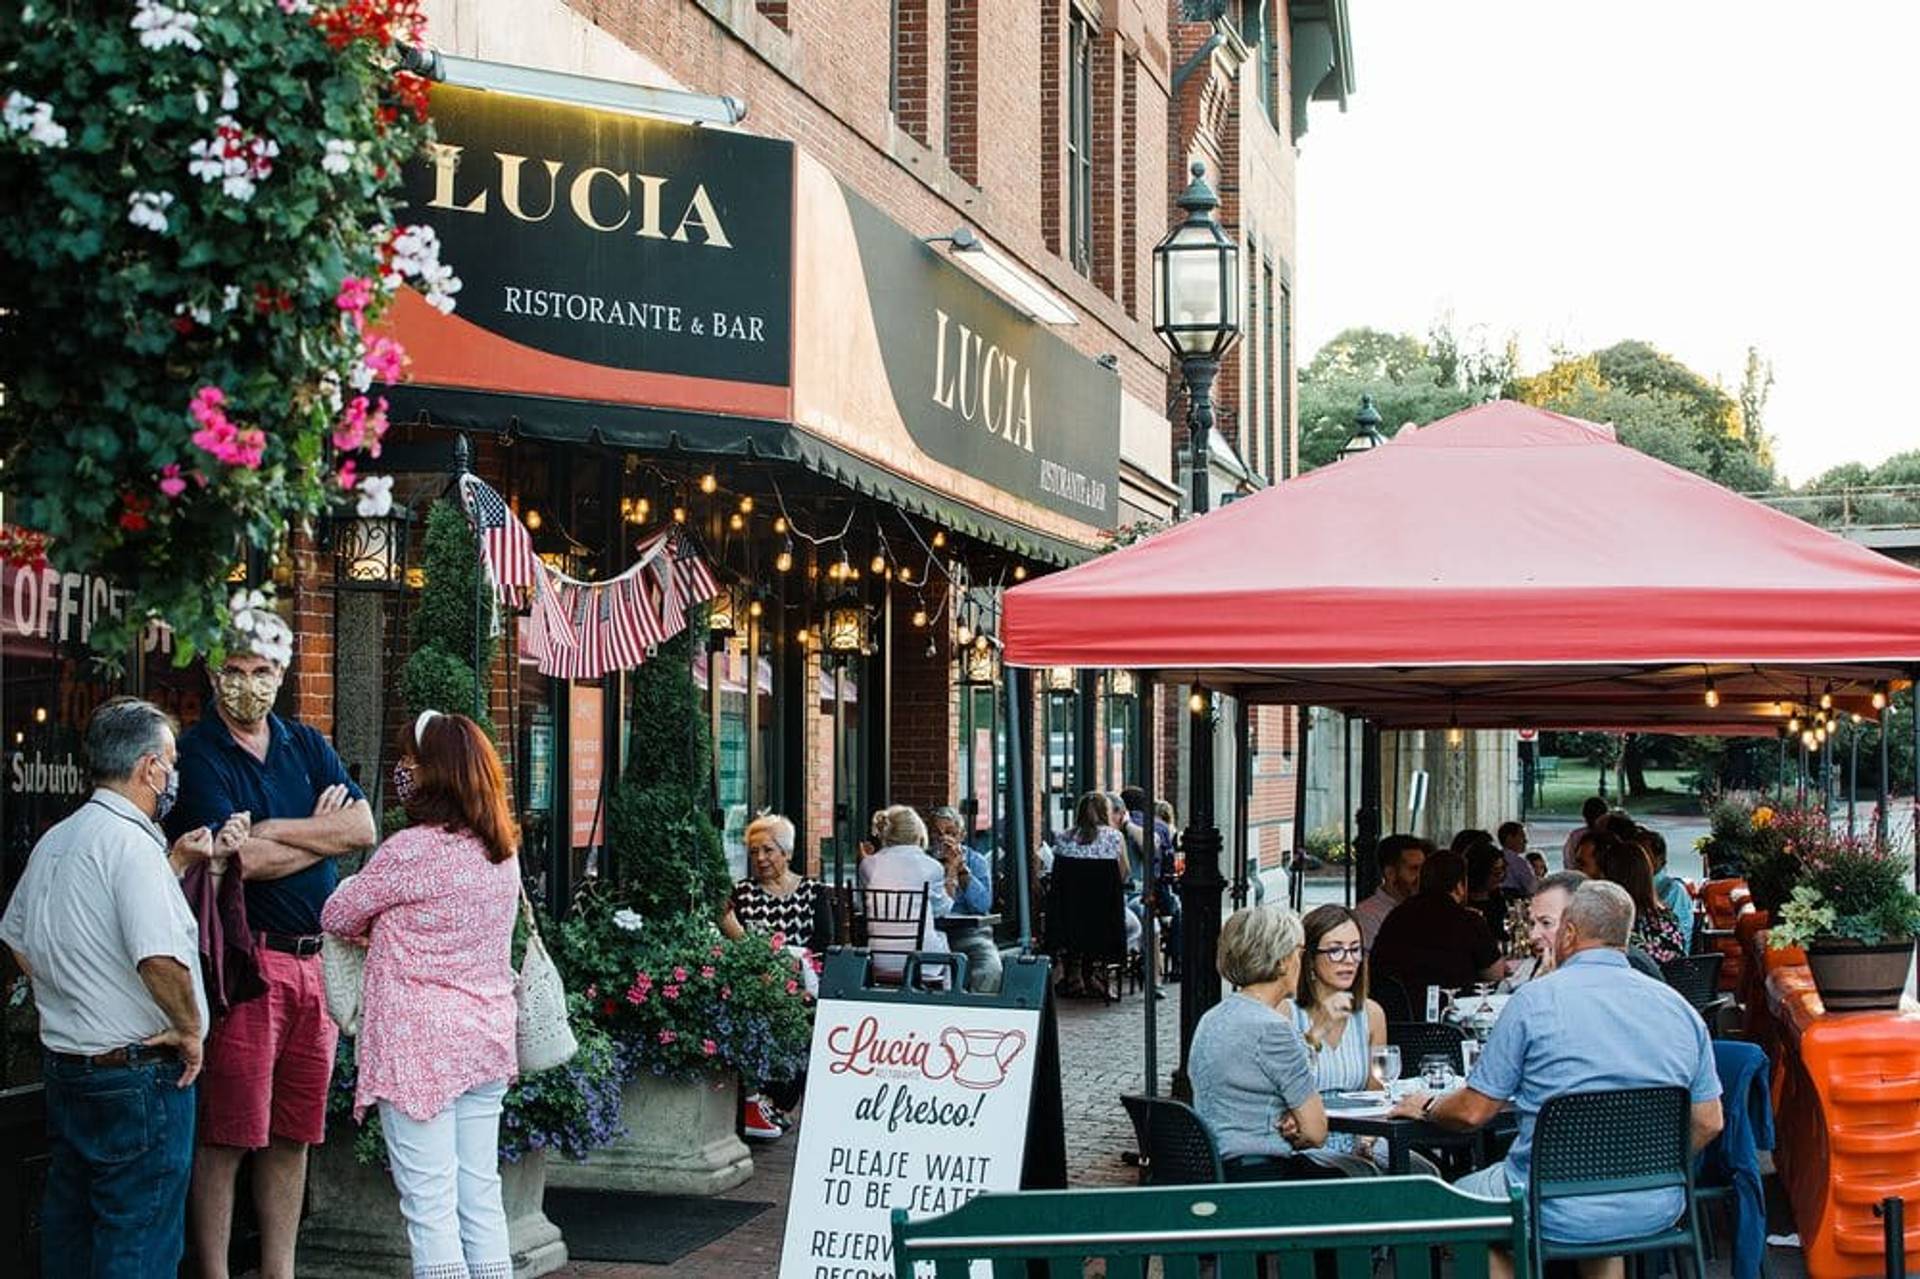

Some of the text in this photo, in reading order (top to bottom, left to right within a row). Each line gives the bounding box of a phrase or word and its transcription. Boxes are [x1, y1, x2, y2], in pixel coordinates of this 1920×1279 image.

[427, 143, 733, 249] LUCIA
[504, 286, 765, 342] RISTORANTE & BAR
[932, 308, 1034, 453] LUCIA
[828, 1016, 955, 1080] Lucia
[856, 1083, 986, 1132] al fresco!
[824, 1178, 851, 1206] TO
[865, 1182, 892, 1208] BE
[829, 1148, 991, 1184] PLEASE WAIT
